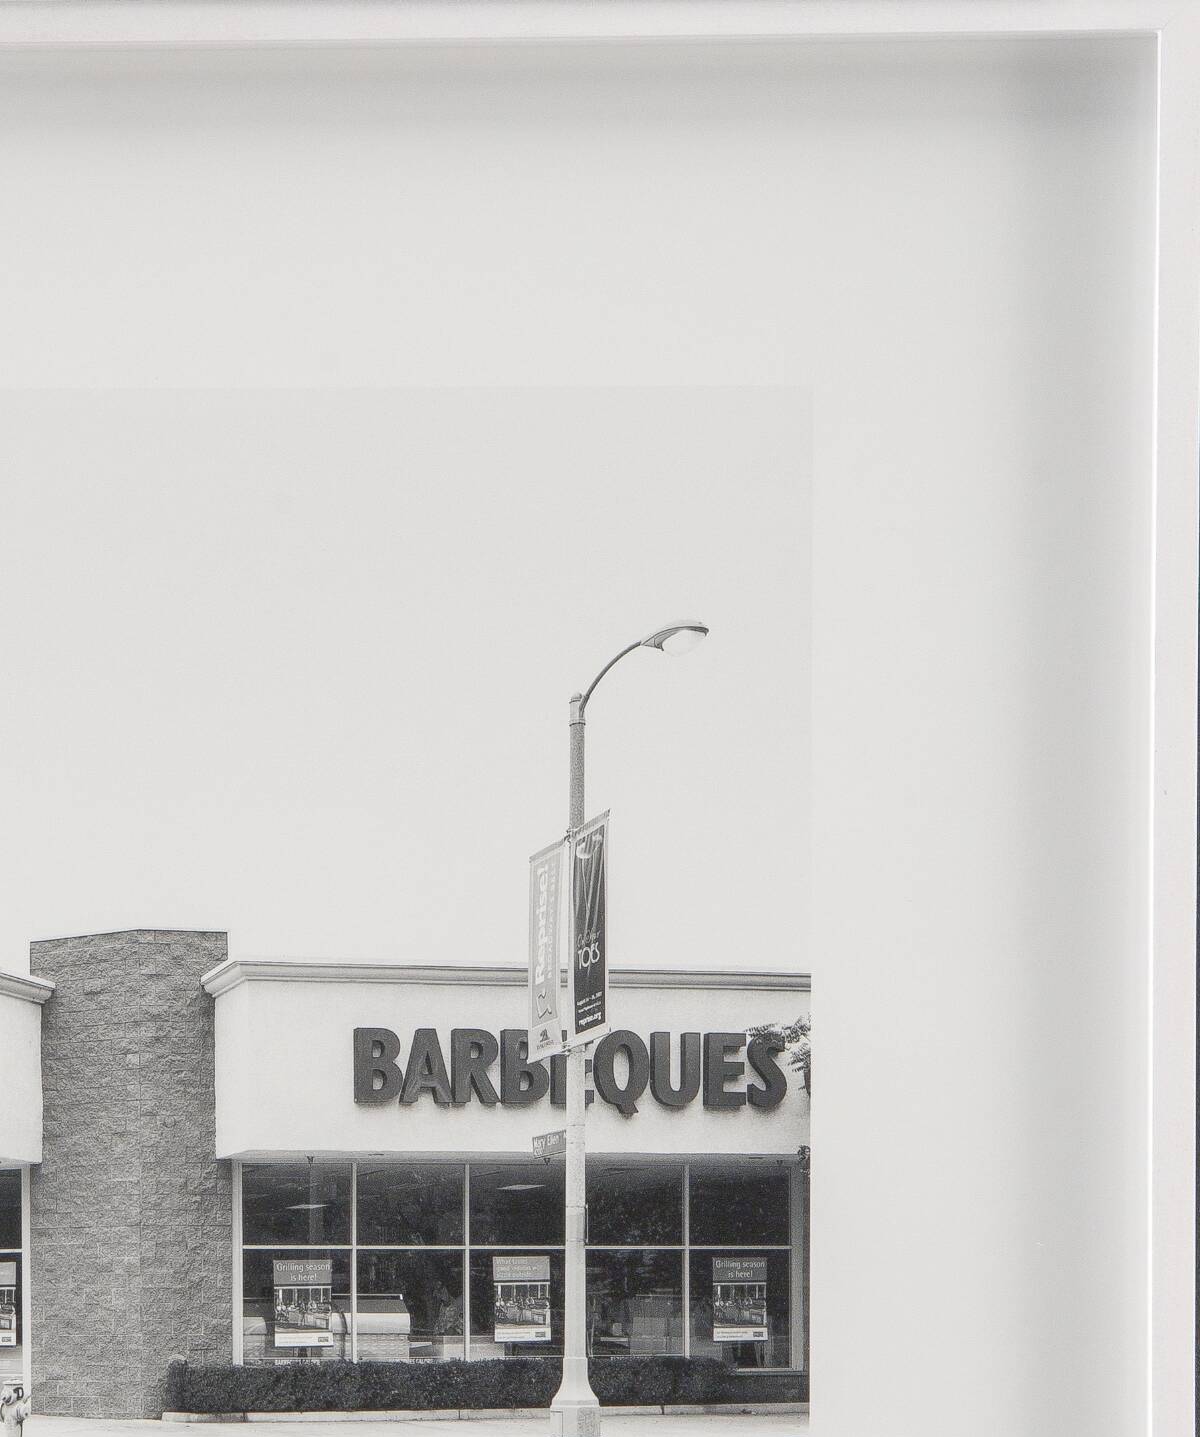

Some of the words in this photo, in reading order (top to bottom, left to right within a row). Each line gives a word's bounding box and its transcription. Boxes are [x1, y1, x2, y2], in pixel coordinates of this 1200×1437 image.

[535, 864, 548, 985] Reprise!
[276, 1262, 304, 1273] Grilling
[715, 1260, 741, 1270] Grilling
[290, 1273, 297, 1281] is
[298, 1273, 317, 1281] here!
[735, 1270, 753, 1278] here!
